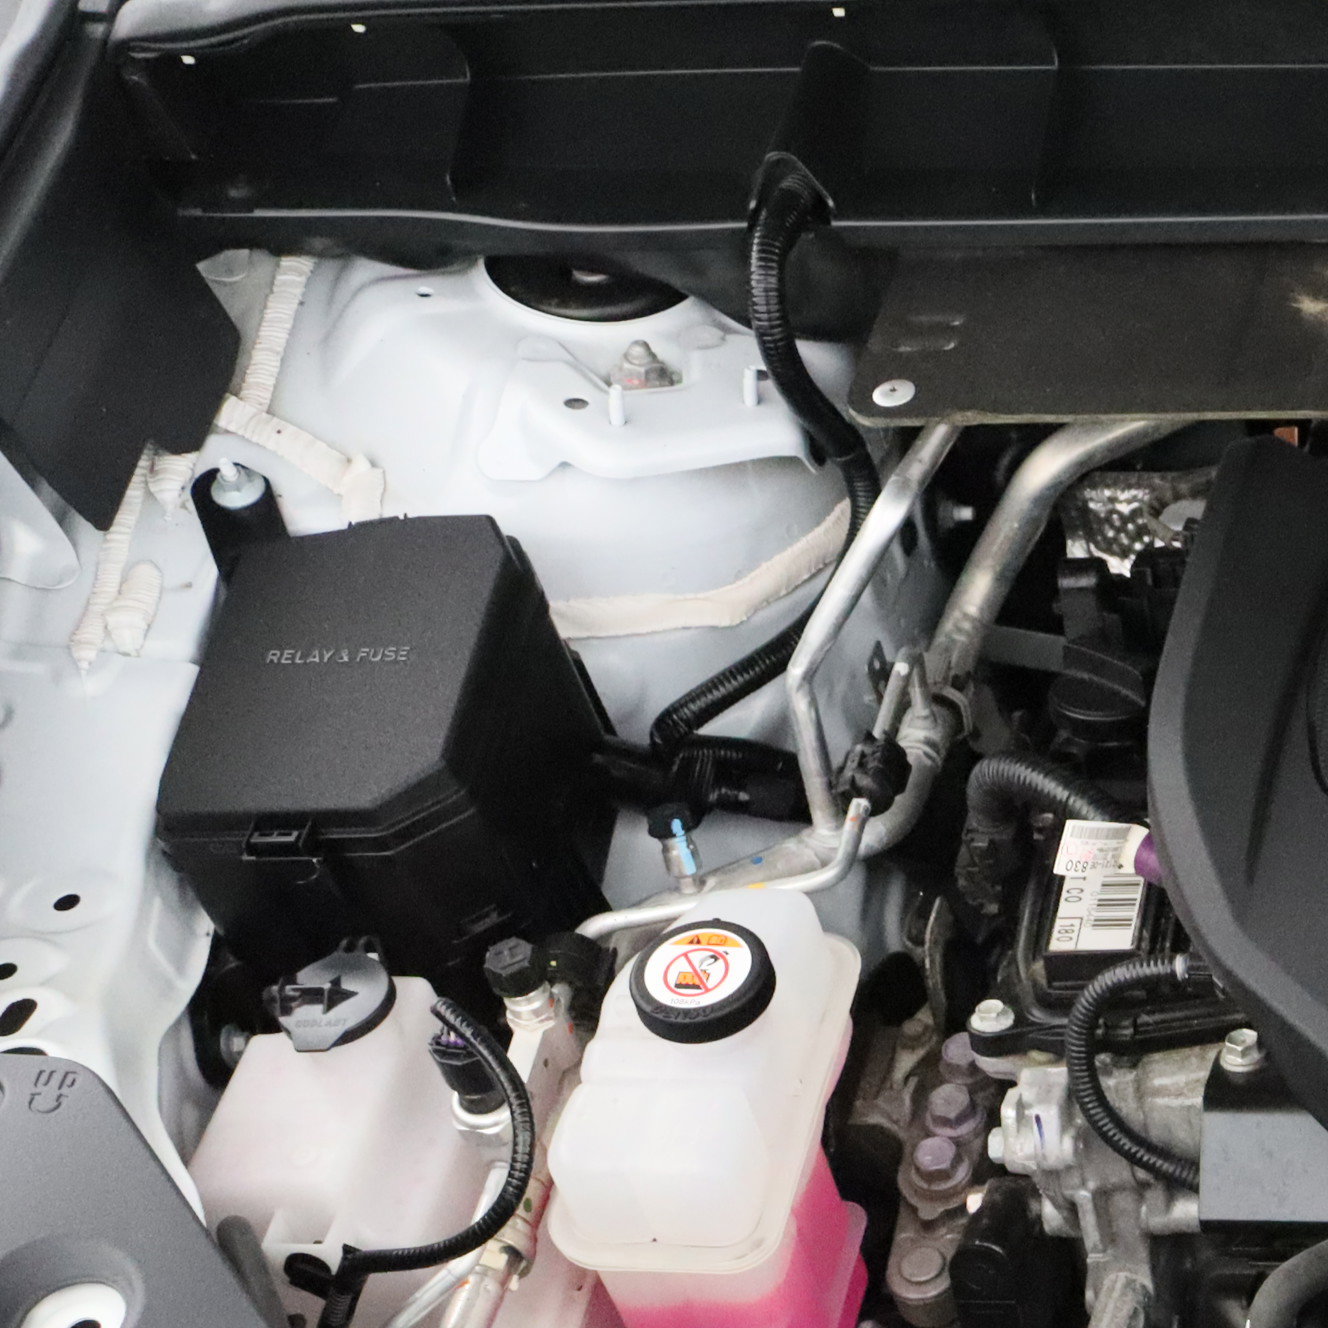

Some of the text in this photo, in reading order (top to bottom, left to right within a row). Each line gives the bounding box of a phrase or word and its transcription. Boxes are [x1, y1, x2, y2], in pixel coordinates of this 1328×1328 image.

[266, 646, 411, 664] RELAY & FUSE
[1056, 923, 1076, 943] 180
